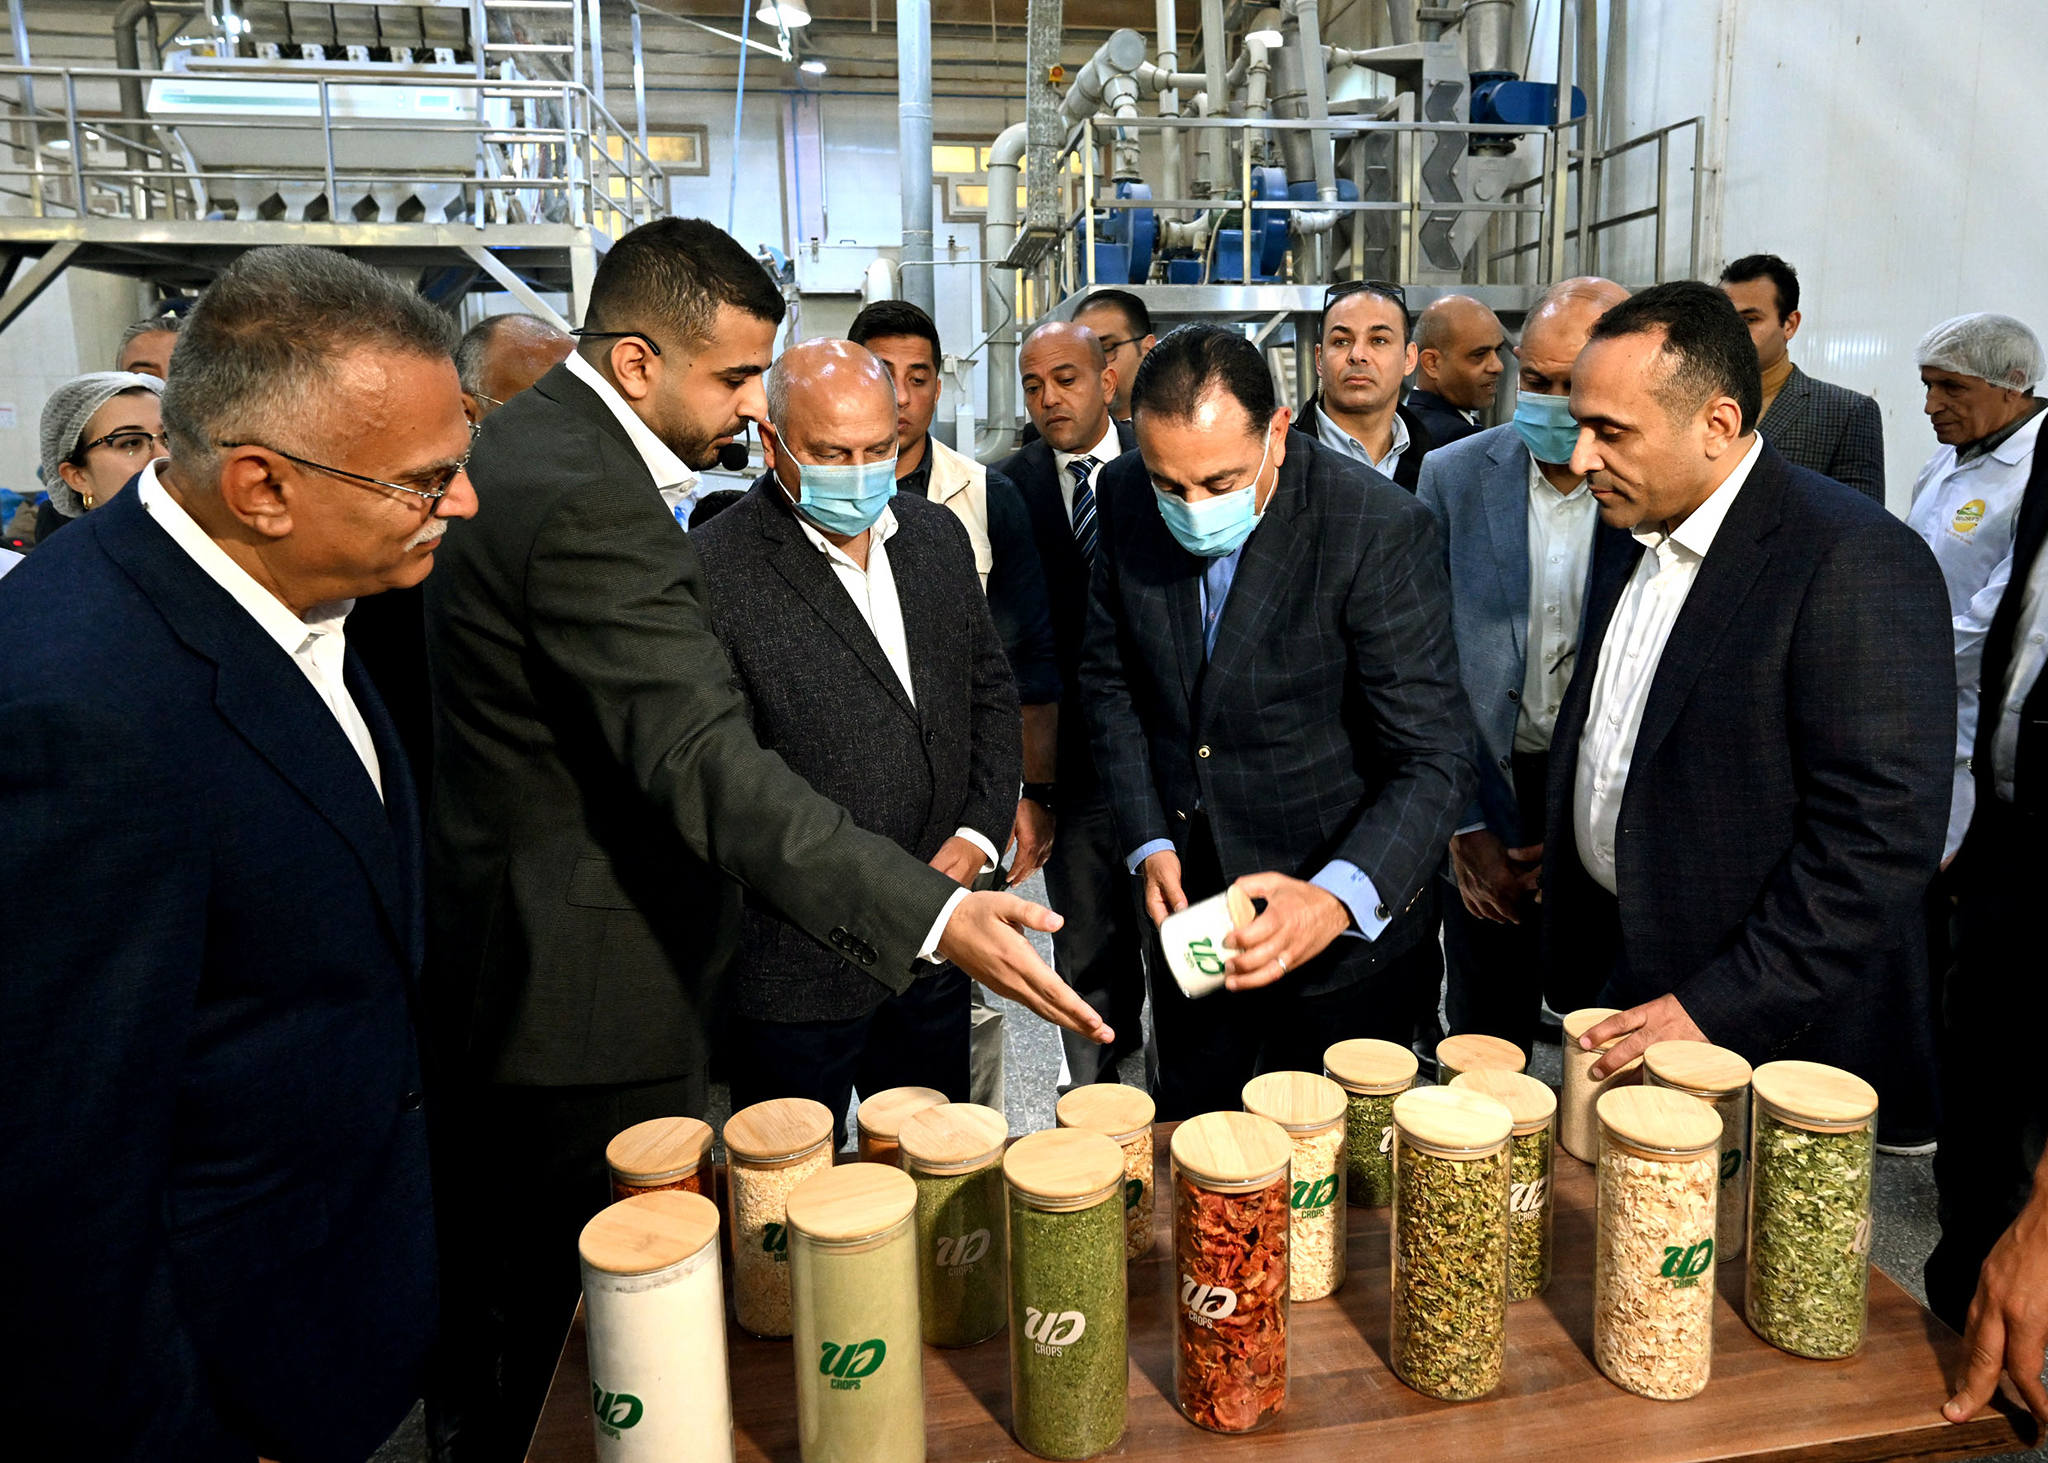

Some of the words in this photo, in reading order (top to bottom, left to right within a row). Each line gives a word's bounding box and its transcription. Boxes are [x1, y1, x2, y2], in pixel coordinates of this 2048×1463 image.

[1301, 1208, 1325, 1219] CROPS
[1188, 1310, 1213, 1329] CROPS
[1034, 1342, 1063, 1358] CROPS
[830, 1378, 862, 1390] CROPS
